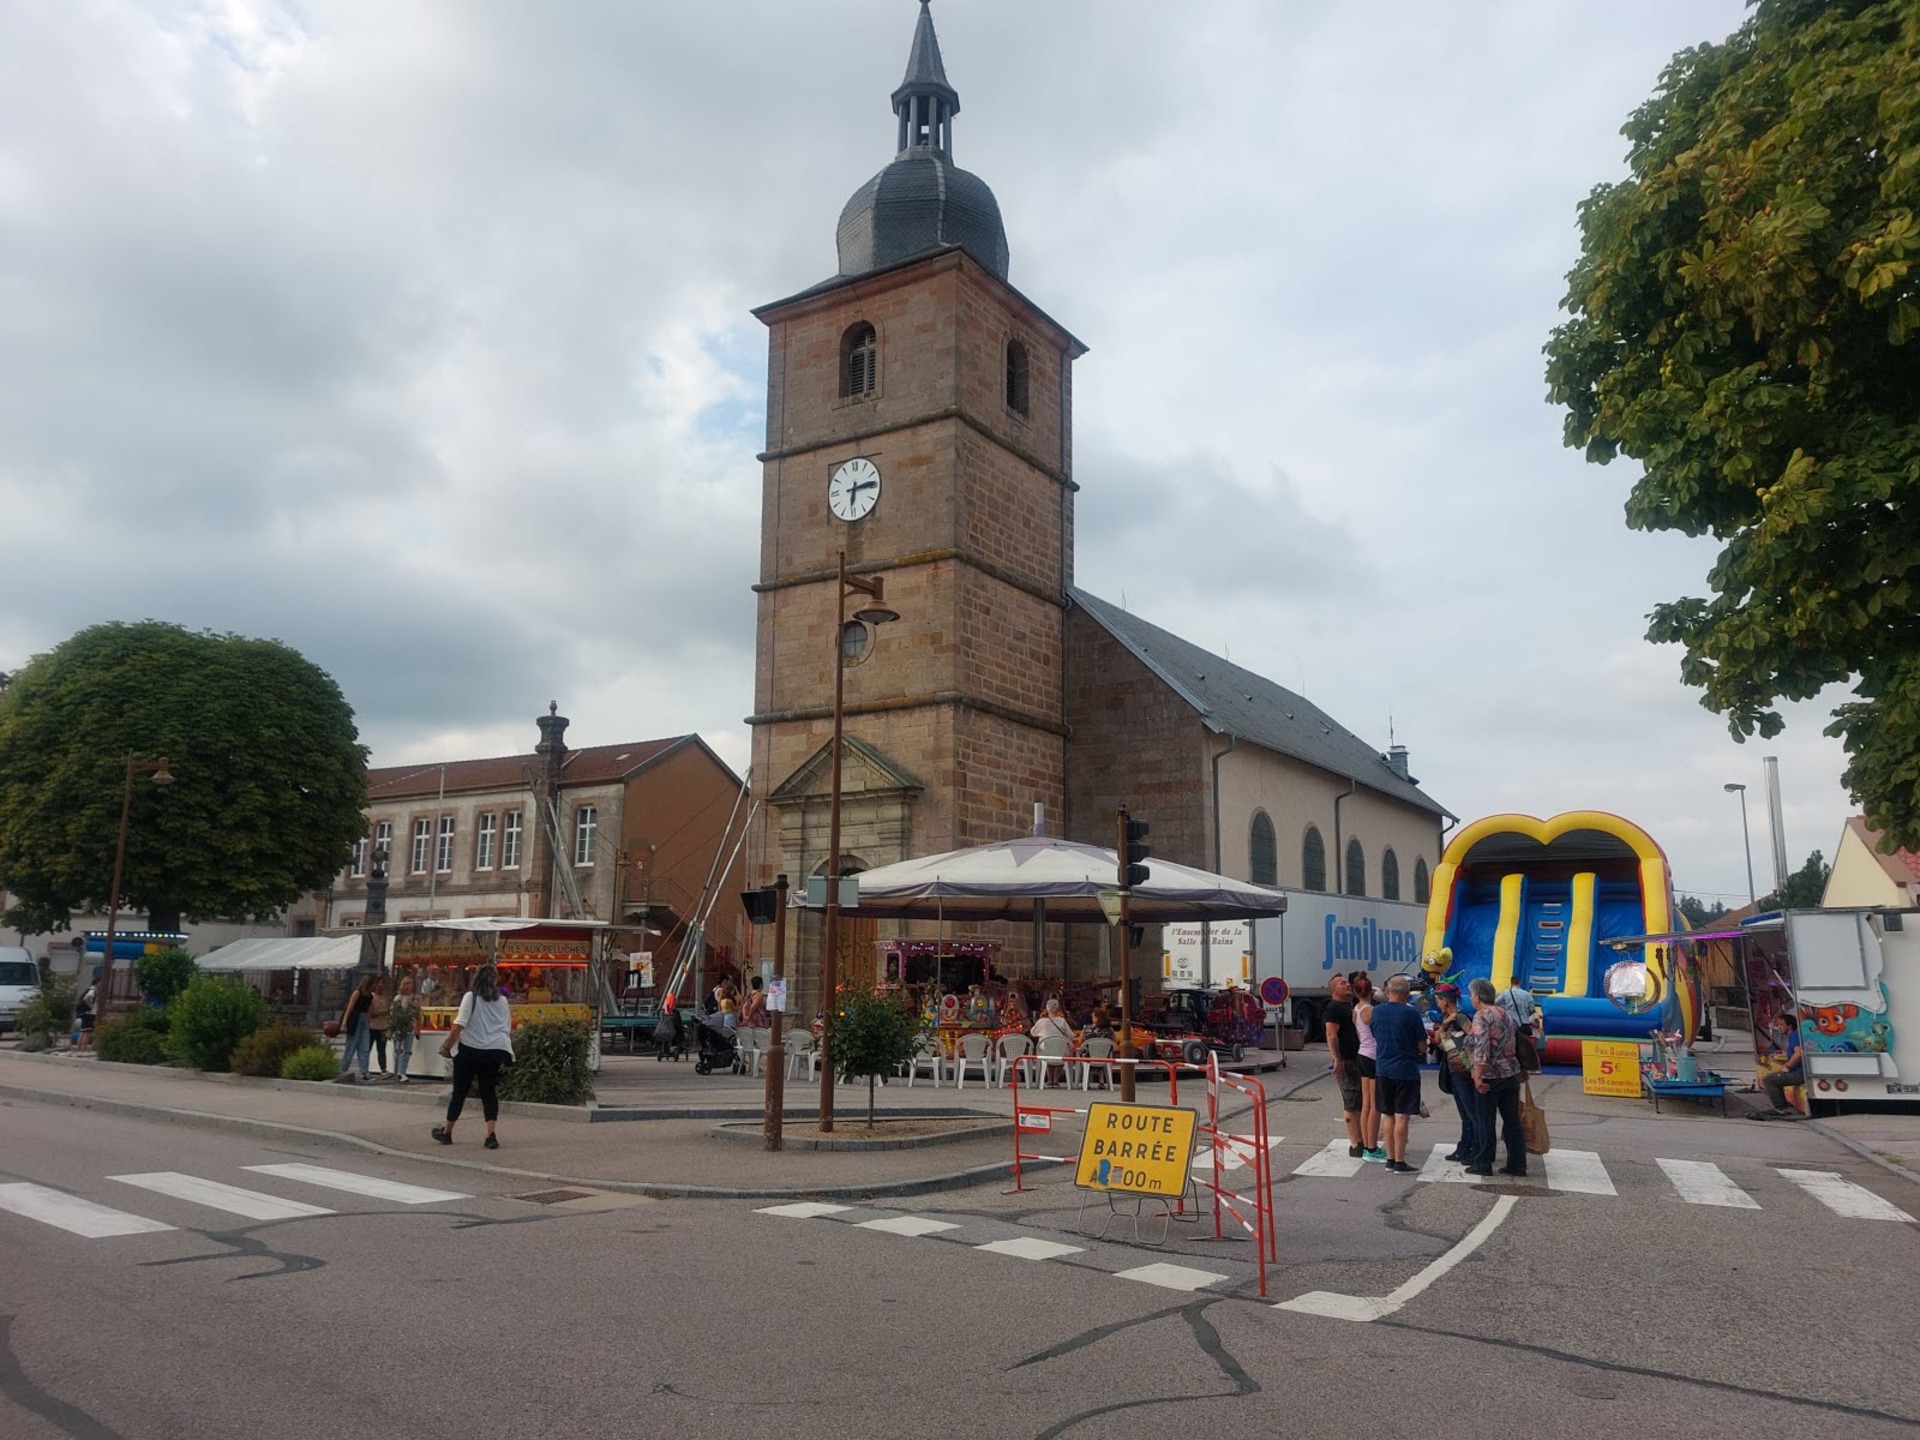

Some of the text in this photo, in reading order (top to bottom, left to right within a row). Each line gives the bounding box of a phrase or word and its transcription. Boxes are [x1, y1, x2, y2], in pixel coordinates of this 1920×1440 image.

[1221, 927, 1231, 936] de
[1234, 927, 1242, 936] la
[1177, 938, 1197, 946] Salle
[1211, 937, 1234, 945] Bains
[524, 945, 541, 954] AUX
[543, 945, 587, 954] PELUCHES
[1106, 1112, 1174, 1133] ROUTE
[1094, 1139, 1177, 1162] BARRÉE
